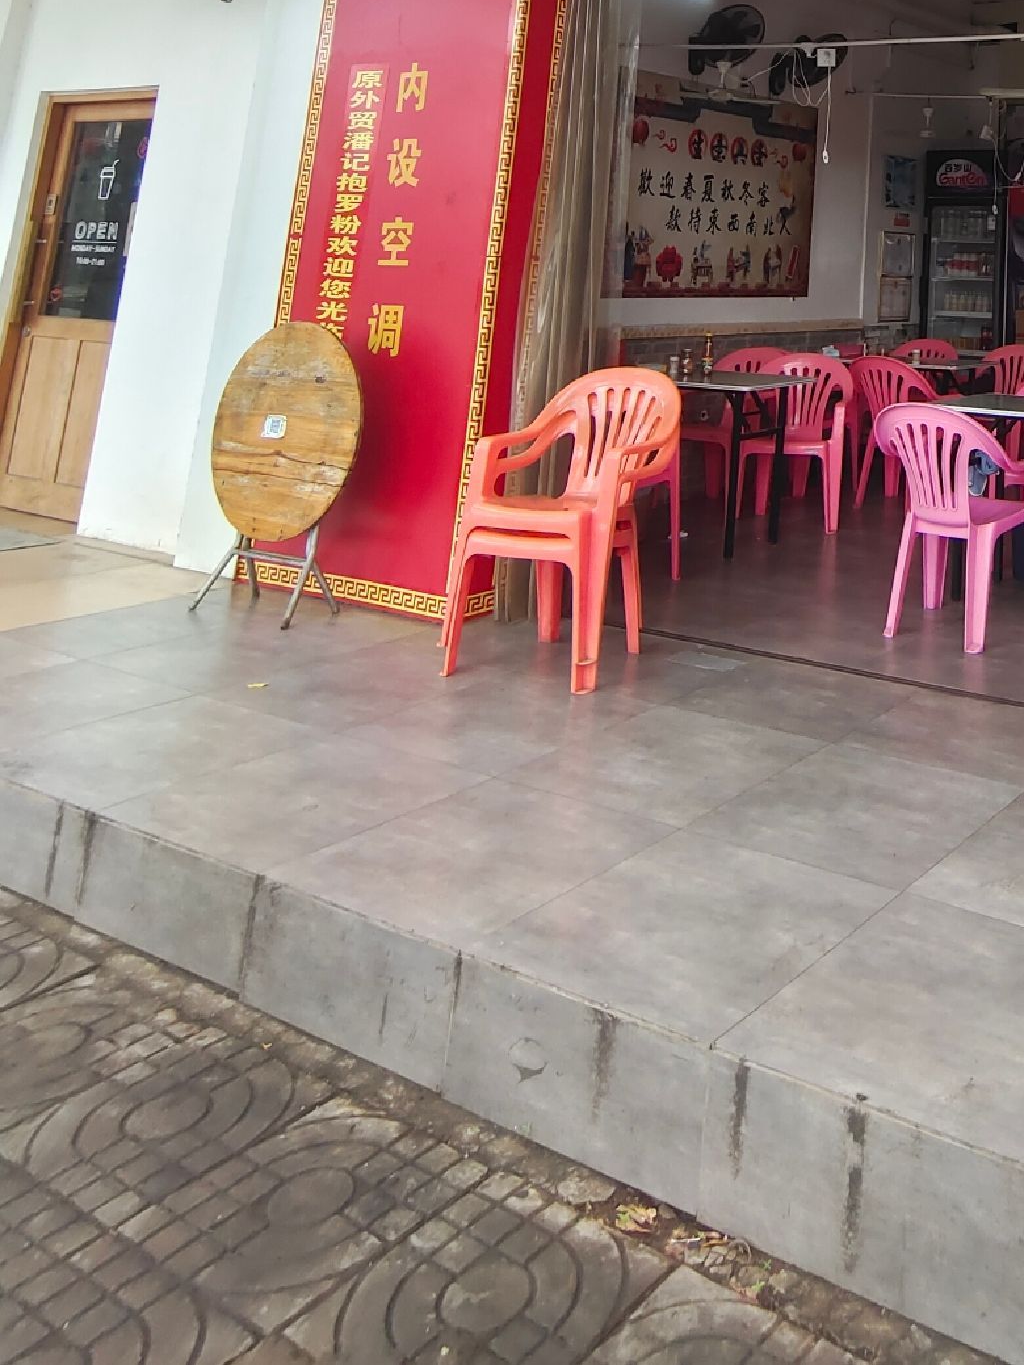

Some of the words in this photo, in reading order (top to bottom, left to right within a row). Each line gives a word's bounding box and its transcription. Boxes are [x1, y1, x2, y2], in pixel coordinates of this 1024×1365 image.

[75, 221, 119, 240] OPEN
[367, 62, 429, 358] 内设空调
